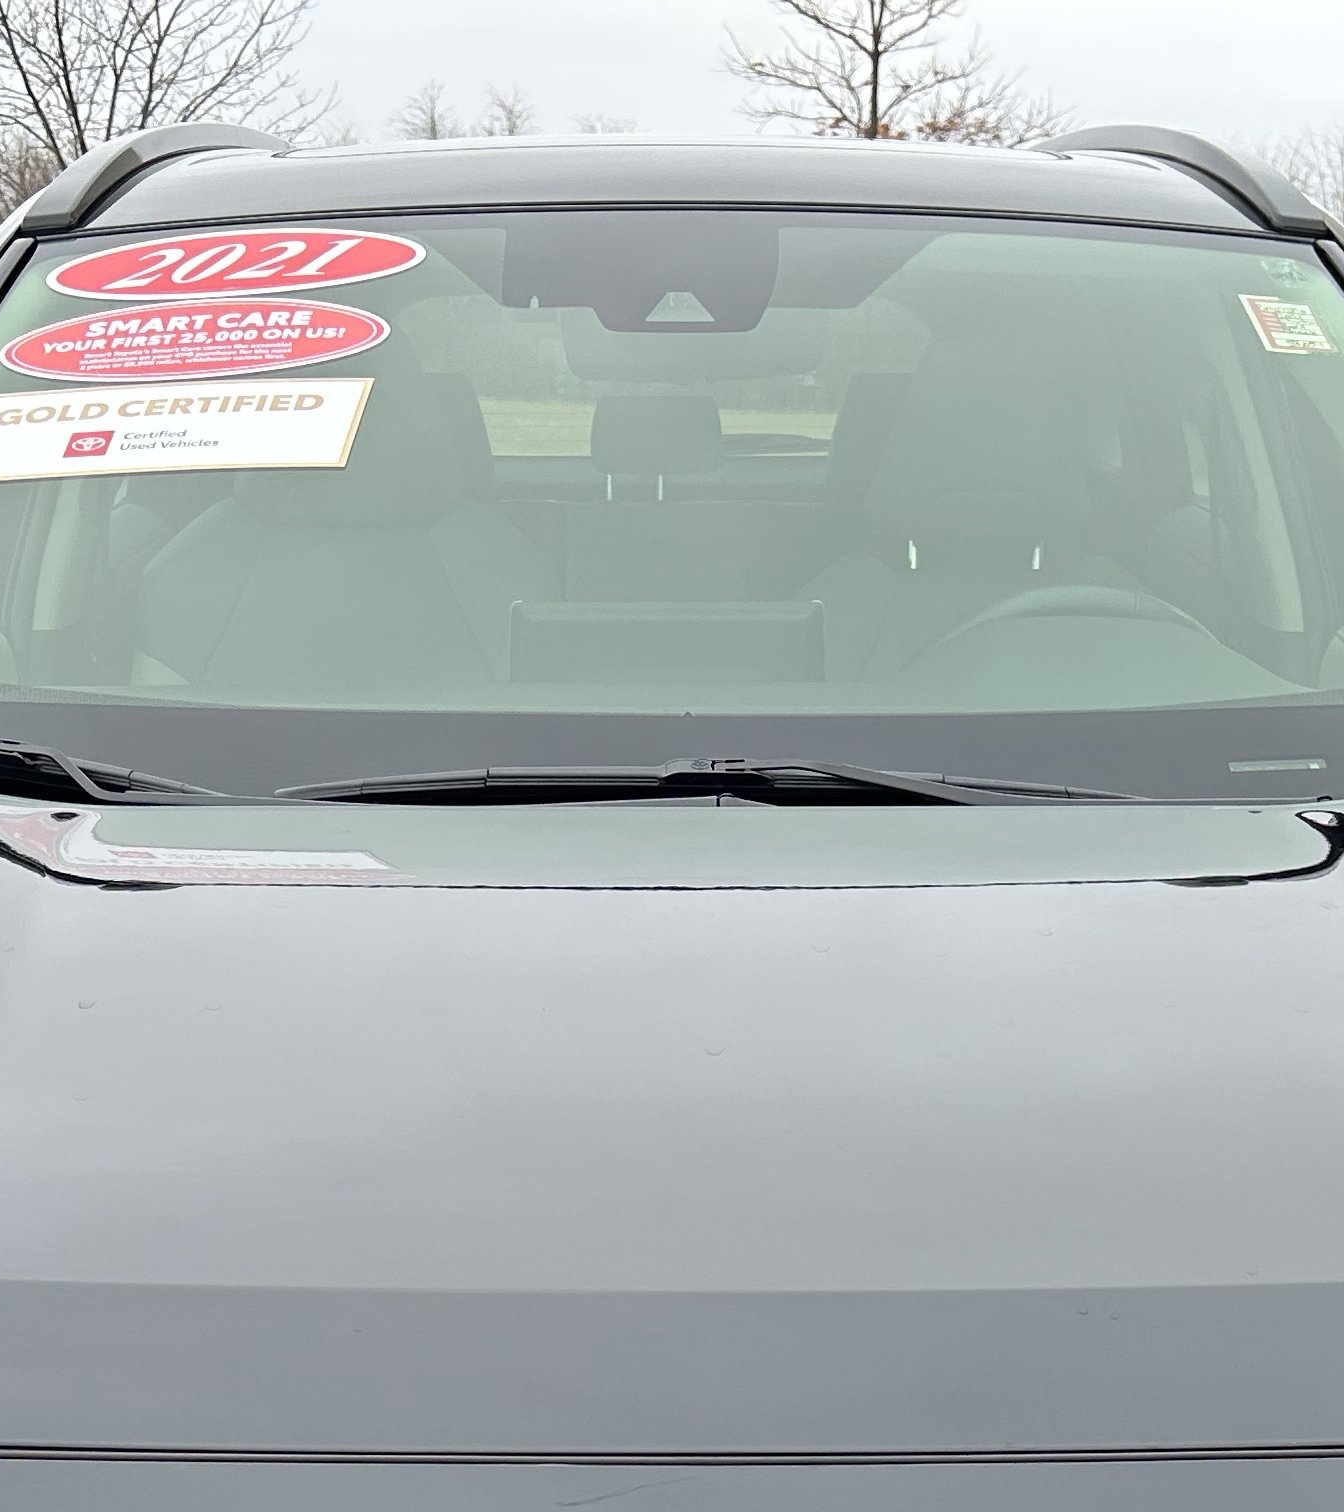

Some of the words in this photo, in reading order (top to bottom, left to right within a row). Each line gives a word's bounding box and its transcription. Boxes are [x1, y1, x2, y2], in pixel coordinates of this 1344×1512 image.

[101, 237, 364, 291] 2021
[85, 314, 213, 338] SMART
[216, 310, 314, 329] CARE
[43, 338, 107, 355] YOUR
[111, 333, 177, 349] FIRST
[178, 329, 258, 345] 25,000
[262, 328, 302, 340] ON
[305, 327, 347, 339] US!
[117, 394, 325, 418] CERTIFIED
[120, 441, 157, 451] Used
[161, 438, 220, 449] Vehicles
[123, 429, 188, 440] Certified
